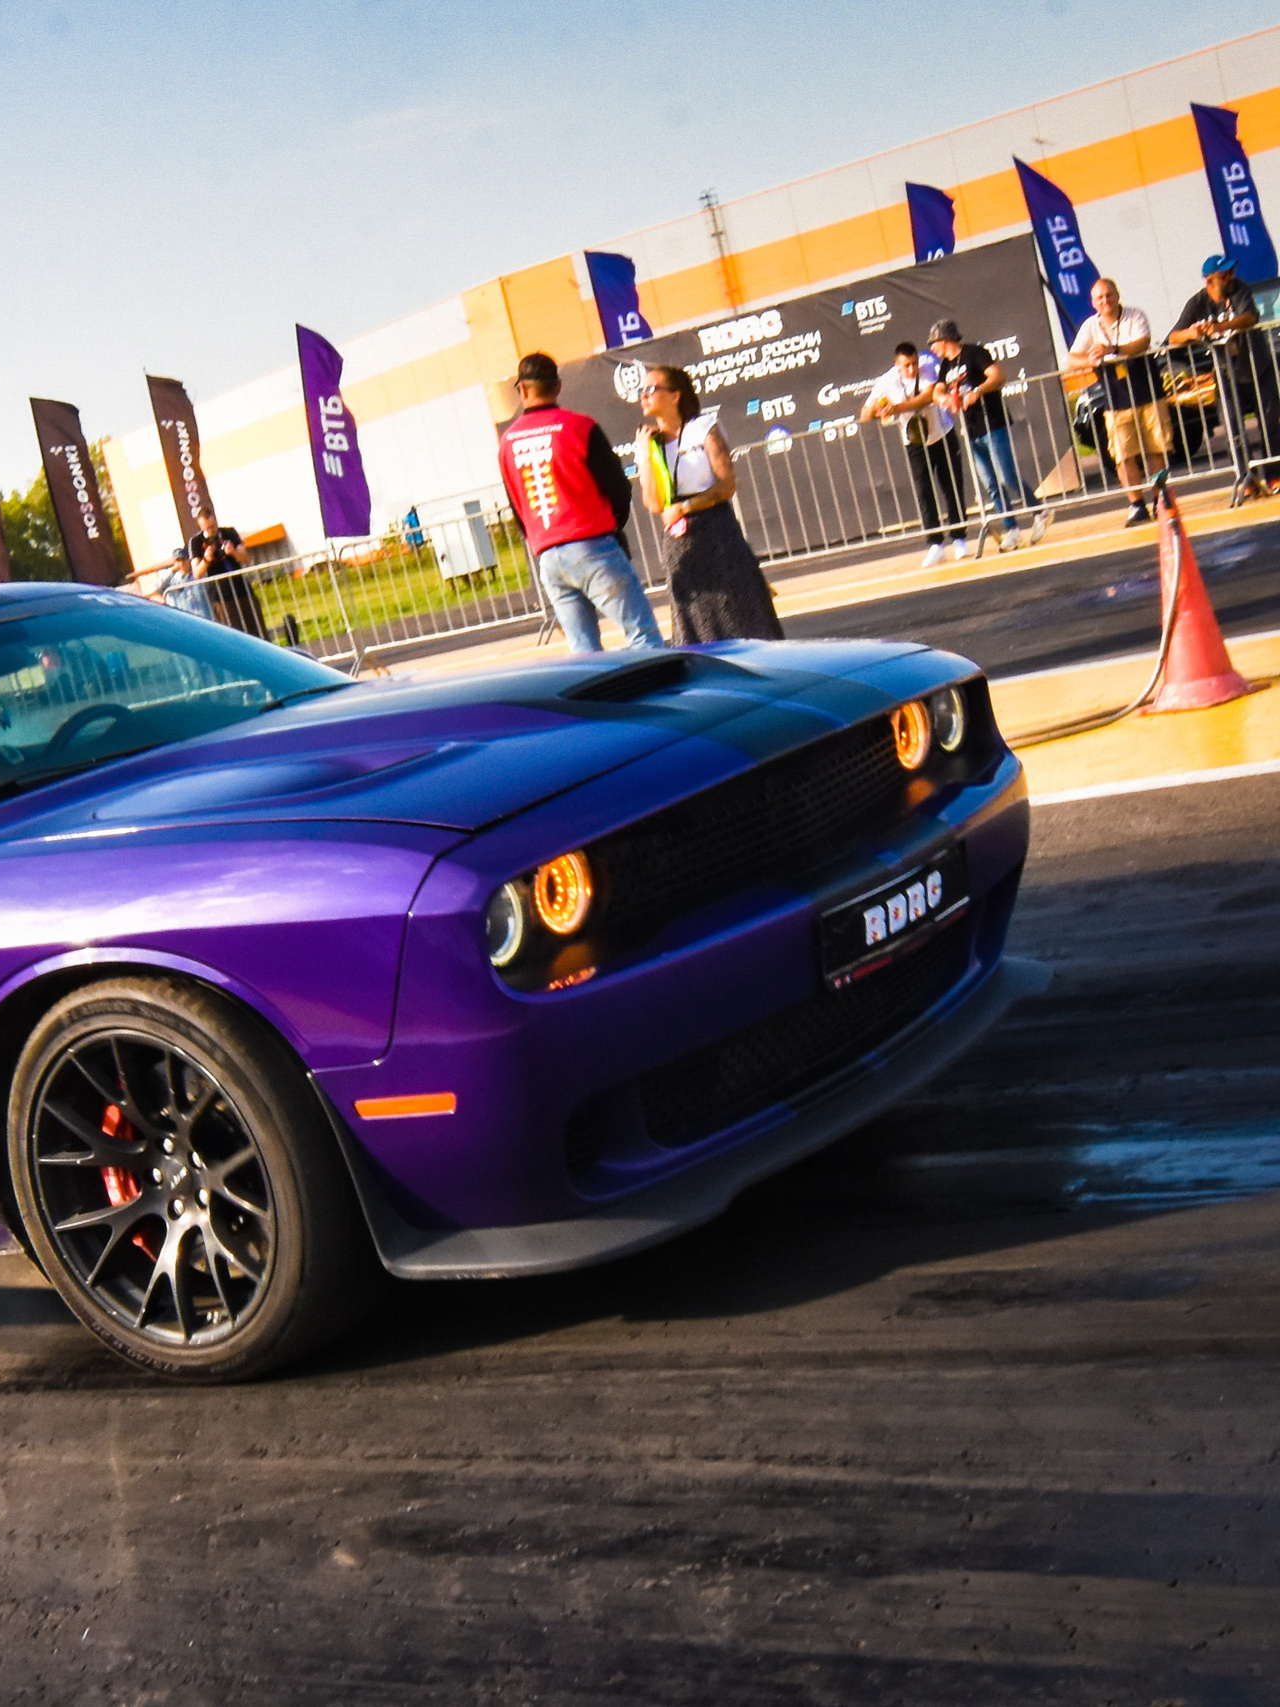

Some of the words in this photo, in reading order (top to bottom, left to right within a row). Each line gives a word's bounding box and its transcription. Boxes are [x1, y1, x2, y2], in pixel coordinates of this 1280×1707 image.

[1222, 160, 1255, 220] ВТБ
[1046, 214, 1085, 269] ВТБ
[617, 311, 643, 346] ТБ
[855, 295, 888, 321] ВТБ
[683, 347, 758, 379] МПИОНАТ
[761, 330, 822, 360] РОССИИ
[319, 394, 349, 452] ВТБ
[760, 395, 797, 421] ВТБ
[823, 415, 859, 442] ВТБ
[64, 444, 100, 540] ROSGONKI
